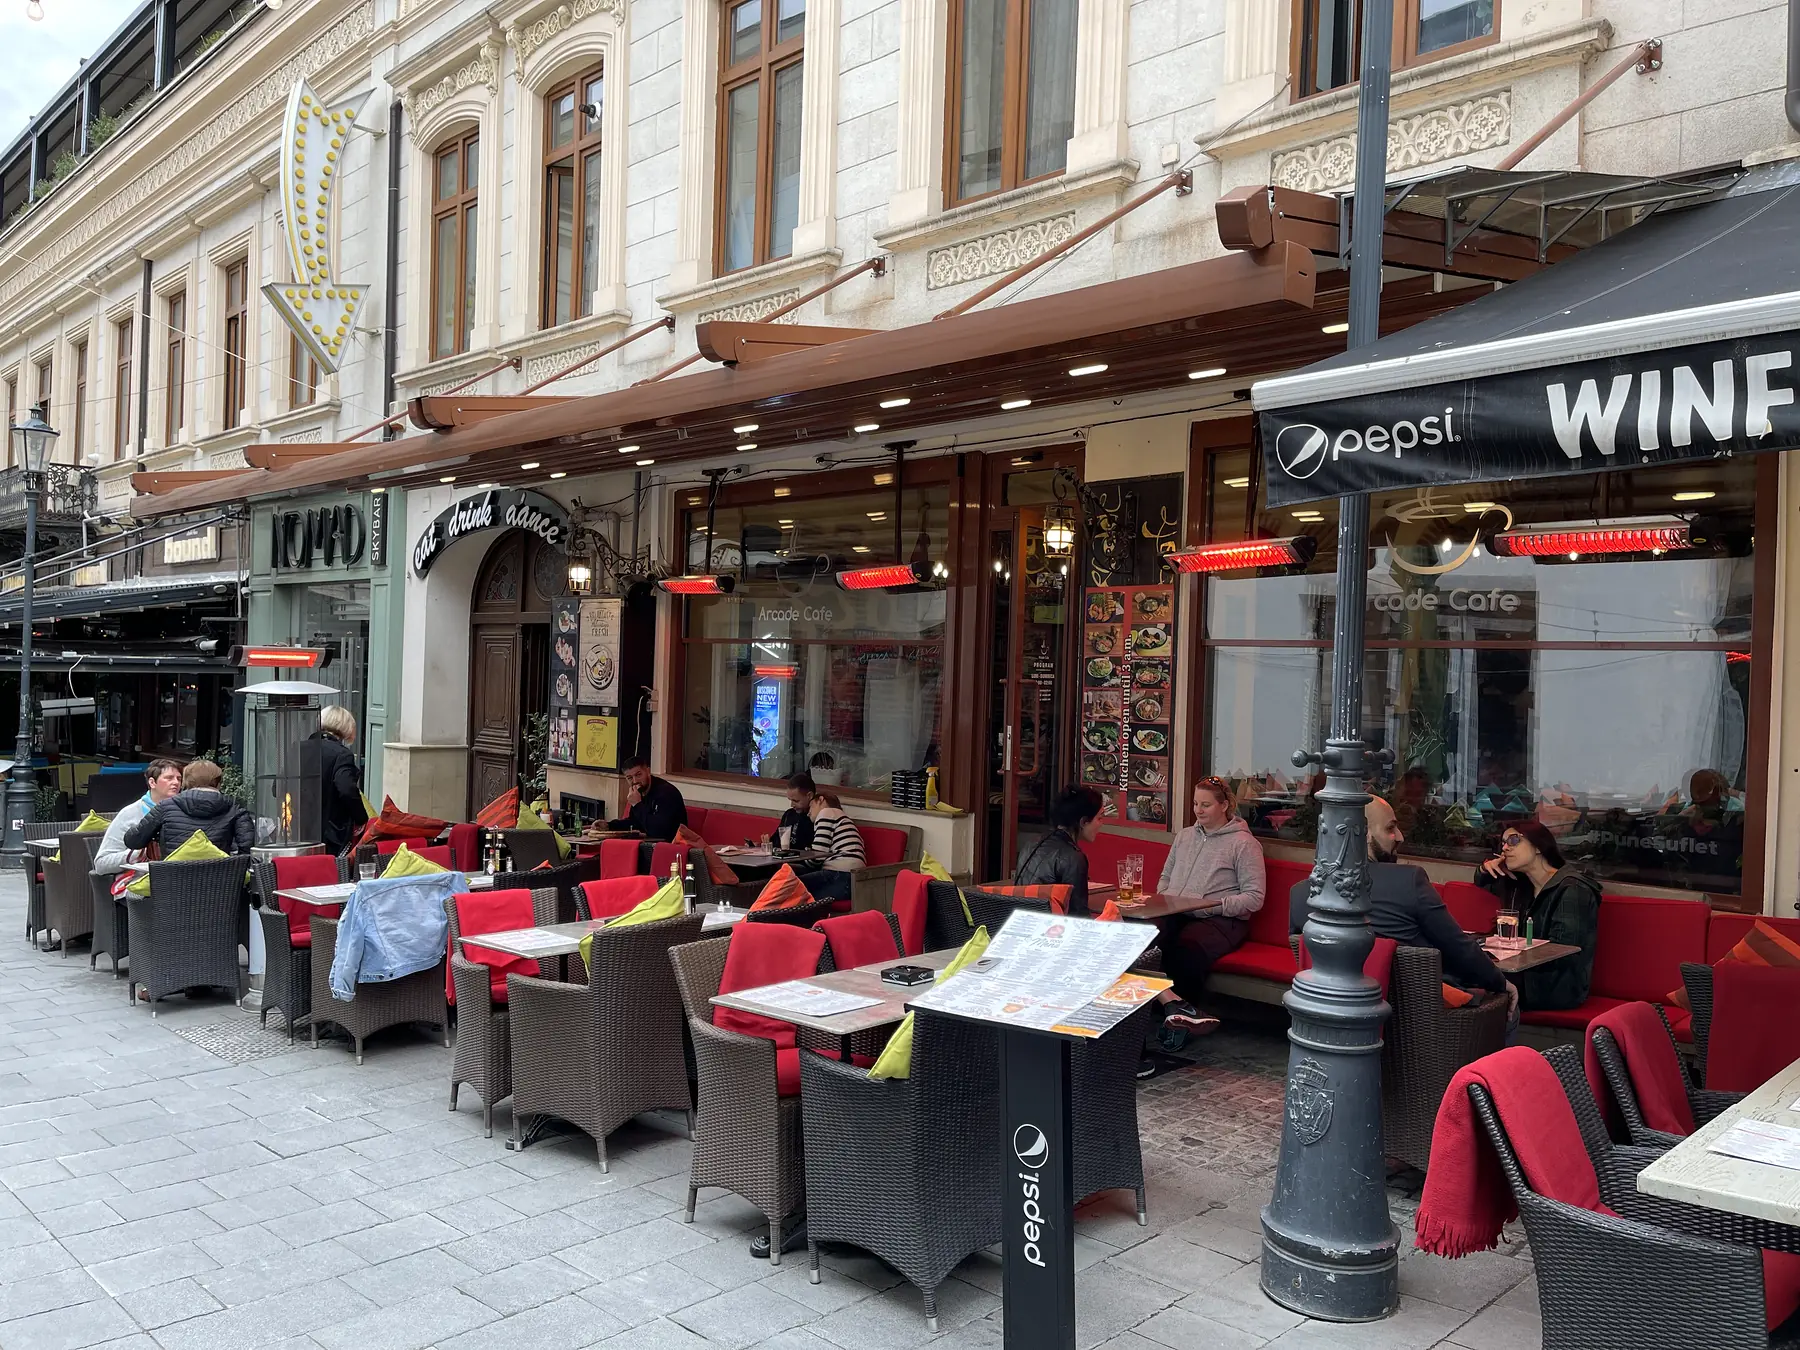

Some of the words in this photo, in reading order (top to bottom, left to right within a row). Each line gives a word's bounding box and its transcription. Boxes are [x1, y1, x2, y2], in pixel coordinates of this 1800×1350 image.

[1332, 406, 1455, 461] pepsi
[271, 503, 367, 569] NOMAD
[371, 496, 382, 561] SKYBAR
[414, 521, 438, 570] eat
[448, 490, 493, 537] drink
[505, 492, 560, 545] dance
[758, 606, 800, 621] Arcade
[803, 606, 833, 621] Cafe
[1372, 587, 1439, 612] cade
[1448, 587, 1522, 612] Cafe
[1123, 634, 1132, 661] a.m.
[1121, 664, 1131, 673] 3
[756, 694, 777, 702] NEW
[1121, 673, 1131, 702] until
[1121, 708, 1132, 739] open
[1119, 743, 1129, 792] Kitchen
[1588, 829, 1719, 856] #PuneSuflet
[1018, 1172, 1046, 1268] pepsi
